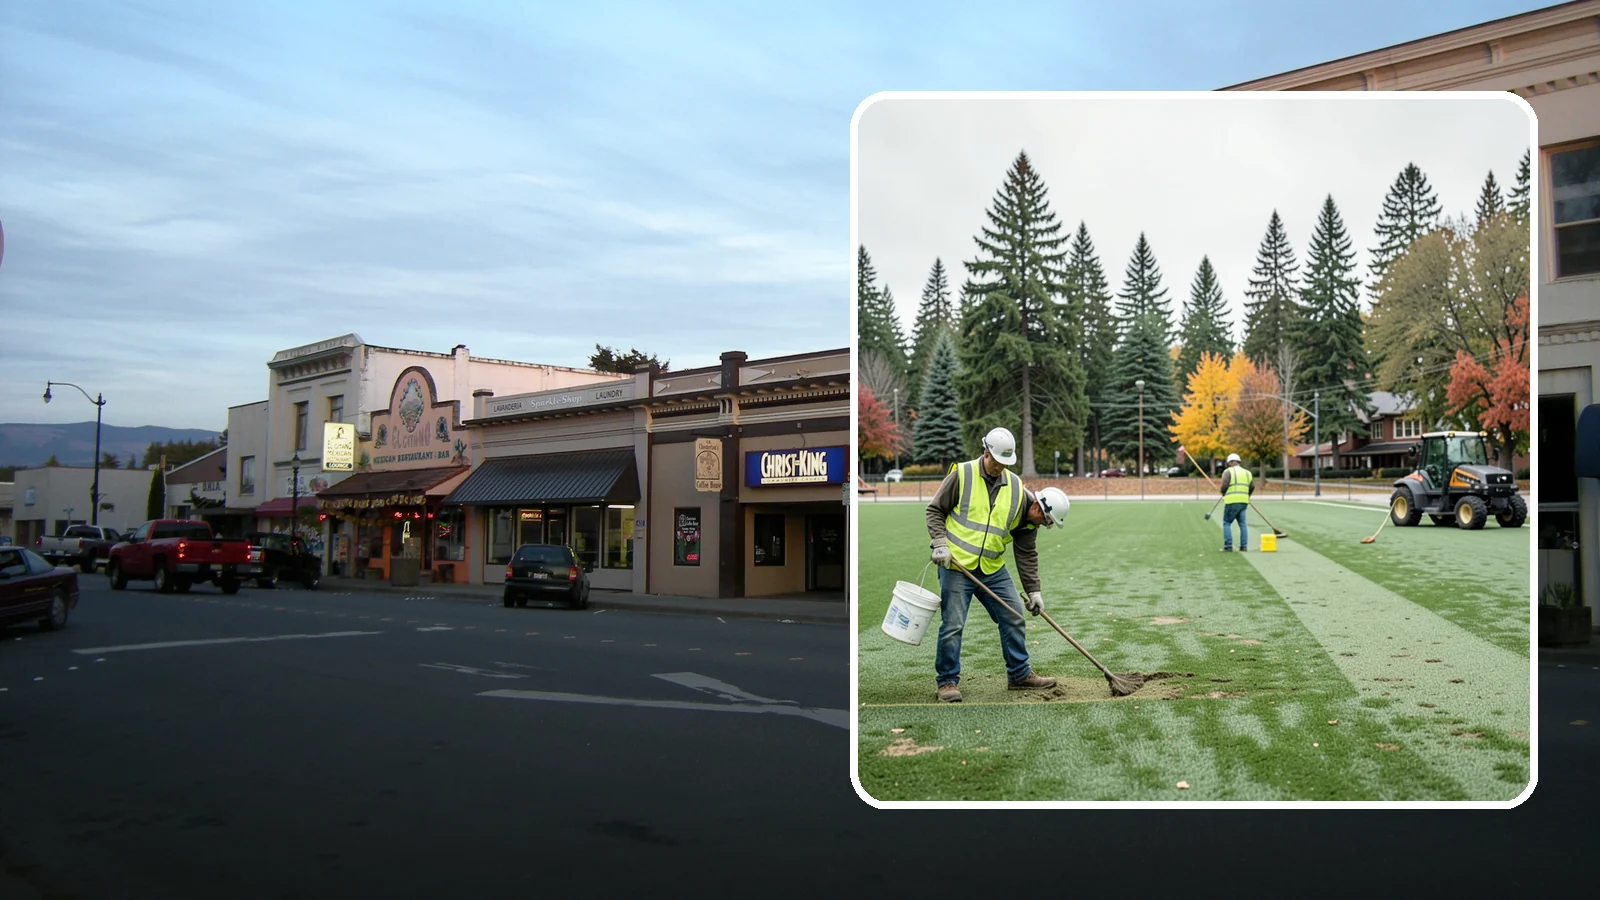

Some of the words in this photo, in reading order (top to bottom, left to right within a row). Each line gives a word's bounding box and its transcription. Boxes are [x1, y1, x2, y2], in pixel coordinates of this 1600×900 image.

[595, 388, 624, 400] LAUNDRY
[493, 402, 523, 413] LAVANDERIA
[530, 397, 561, 409] Sparkle
[562, 394, 582, 406] Shop
[373, 454, 396, 464] MEXICAN
[397, 451, 433, 462] RESTAURANT
[437, 450, 450, 459] BAR
